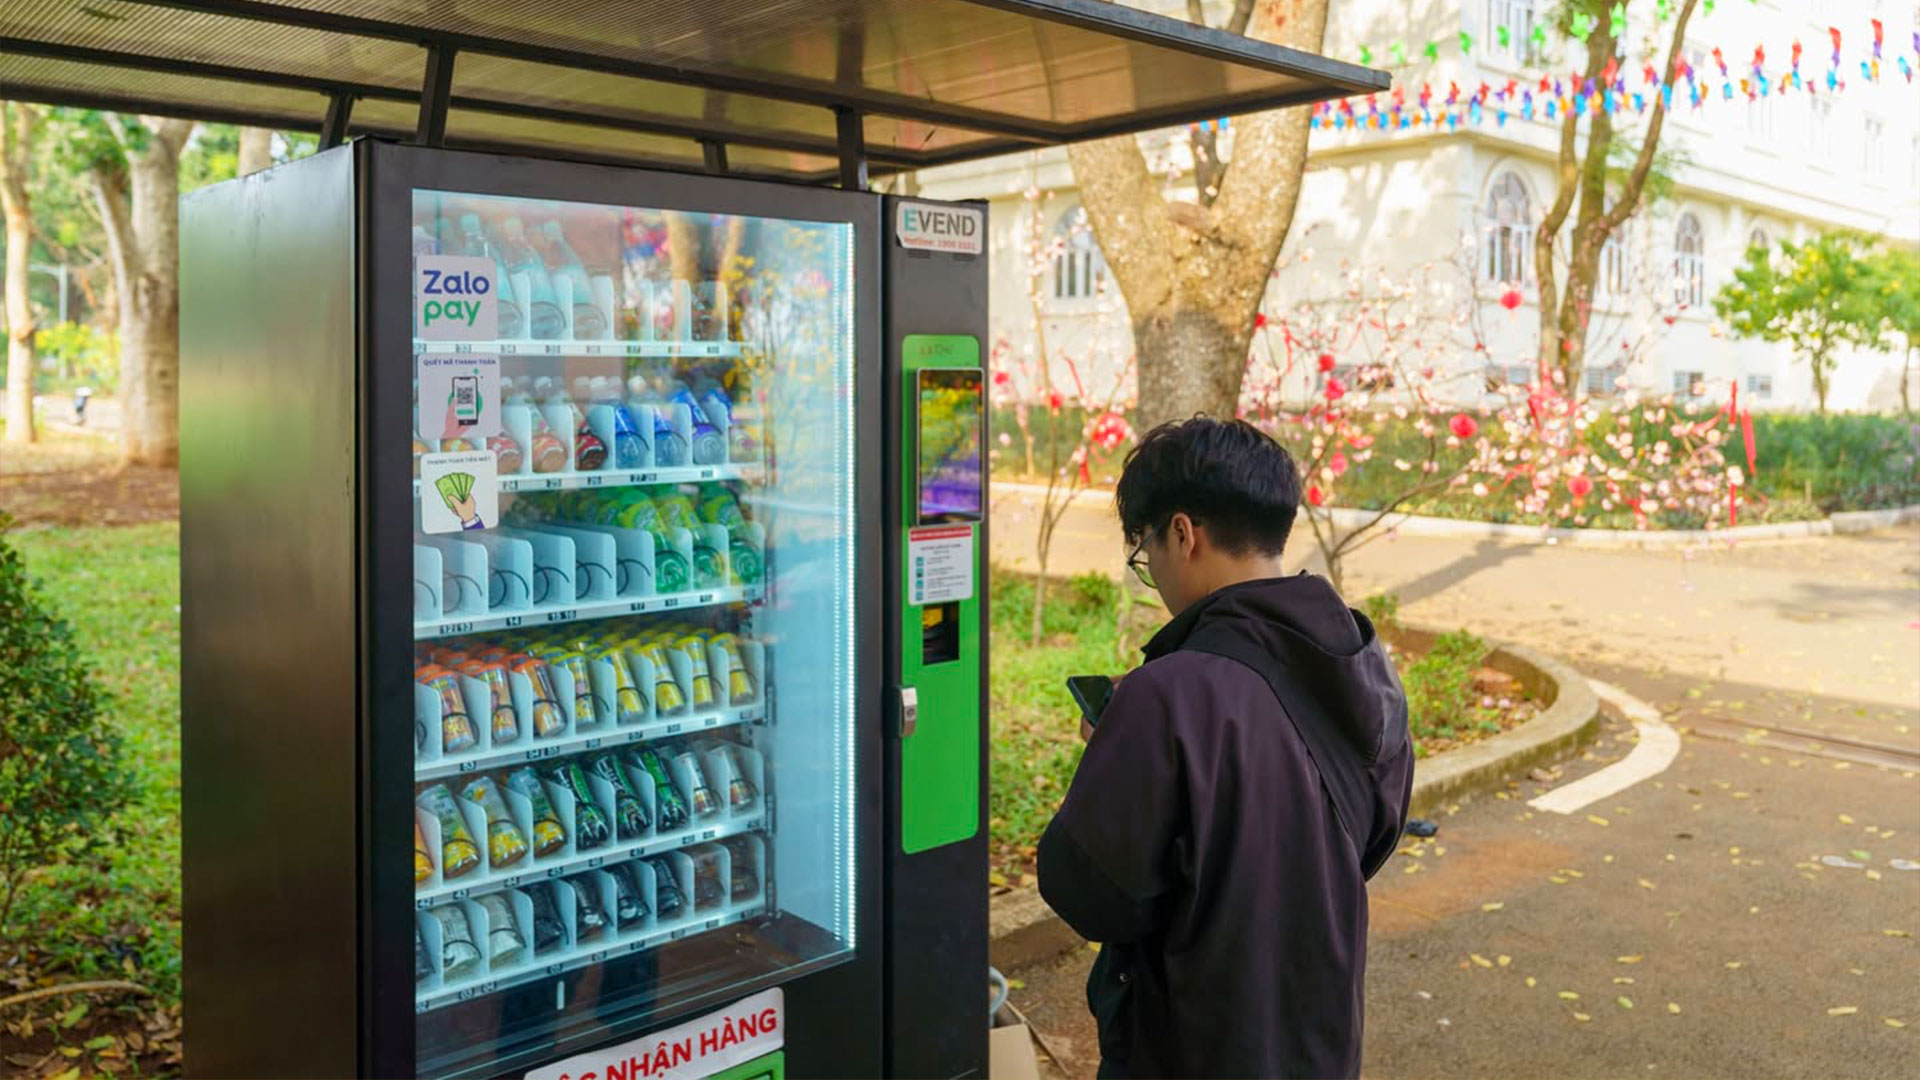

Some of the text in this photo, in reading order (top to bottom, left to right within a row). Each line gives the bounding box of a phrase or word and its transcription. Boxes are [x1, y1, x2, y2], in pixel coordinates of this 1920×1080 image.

[904, 208, 975, 237] EVEND
[423, 269, 490, 295] Zalo
[424, 300, 481, 327] pay
[606, 1008, 777, 1080] NHẬN HÀNG
